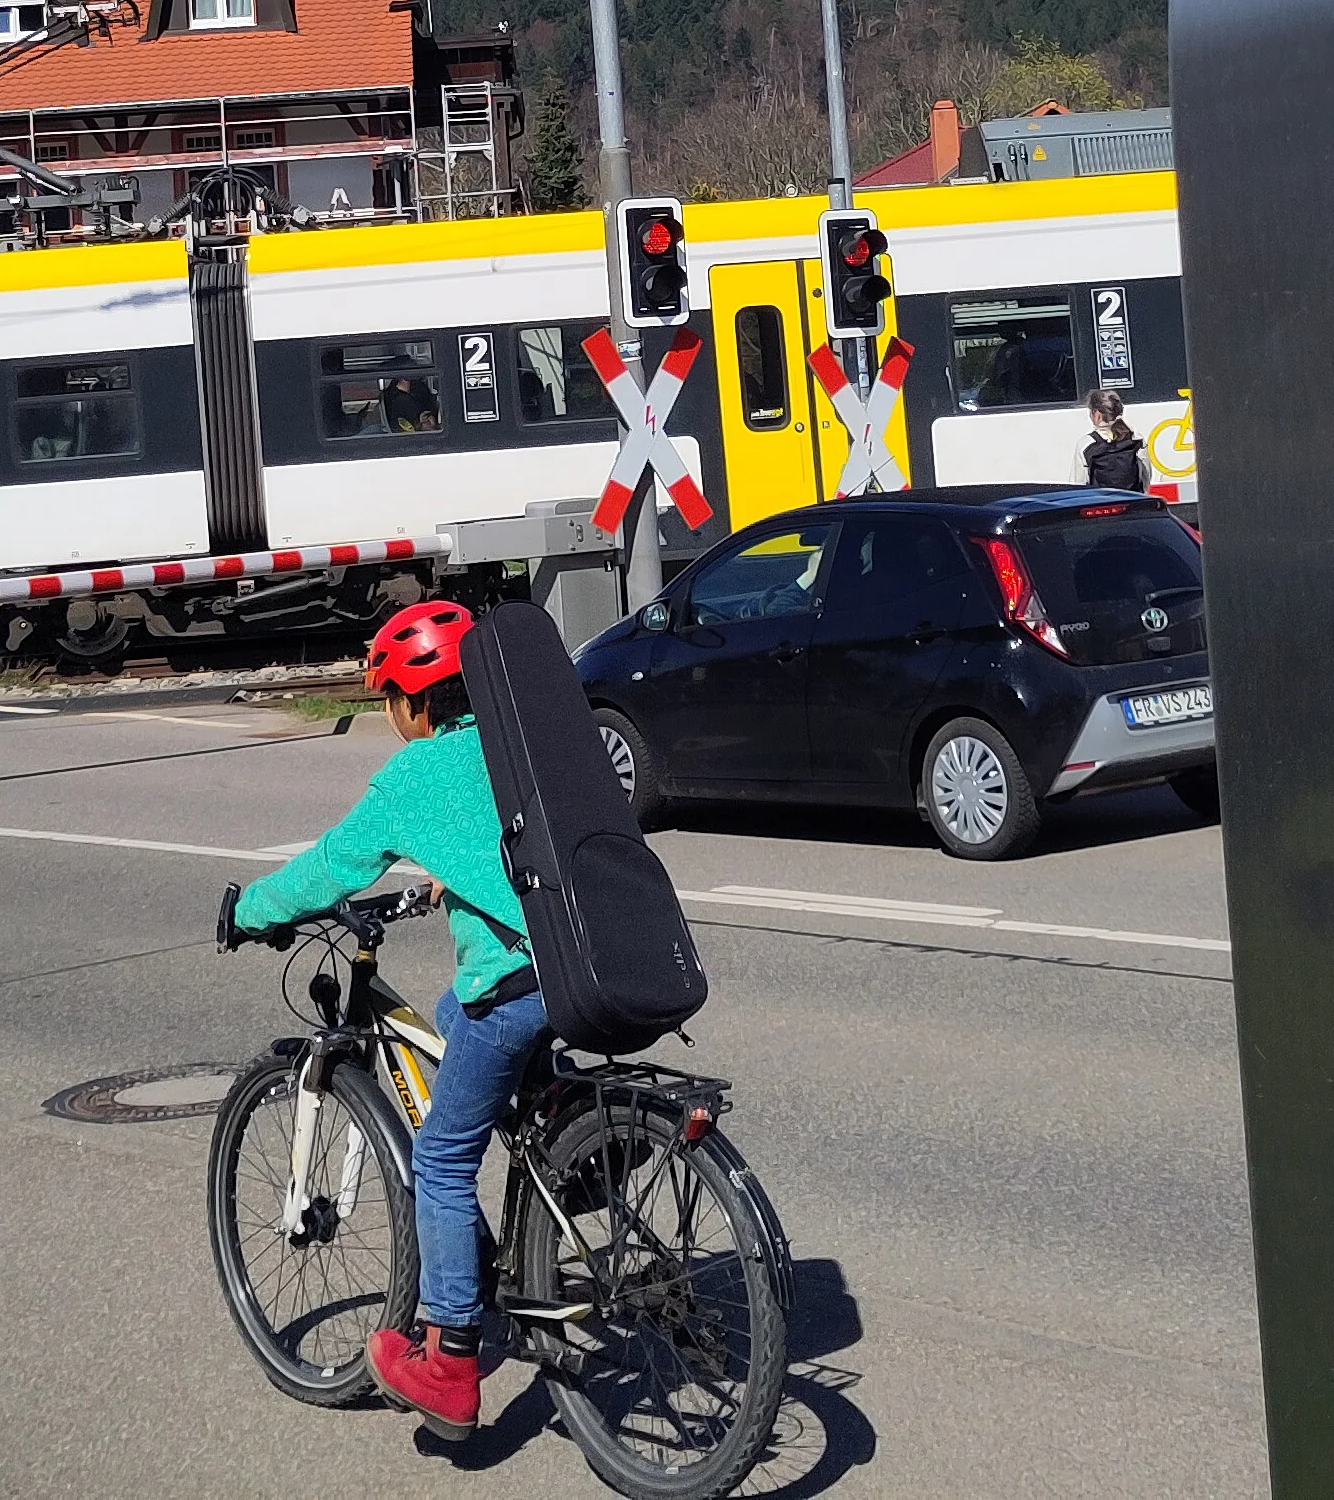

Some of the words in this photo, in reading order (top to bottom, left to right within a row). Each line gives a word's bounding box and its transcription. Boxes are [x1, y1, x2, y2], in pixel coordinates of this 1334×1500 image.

[1097, 290, 1124, 326] 2
[464, 336, 491, 372] 2
[1132, 696, 1156, 720] FR
